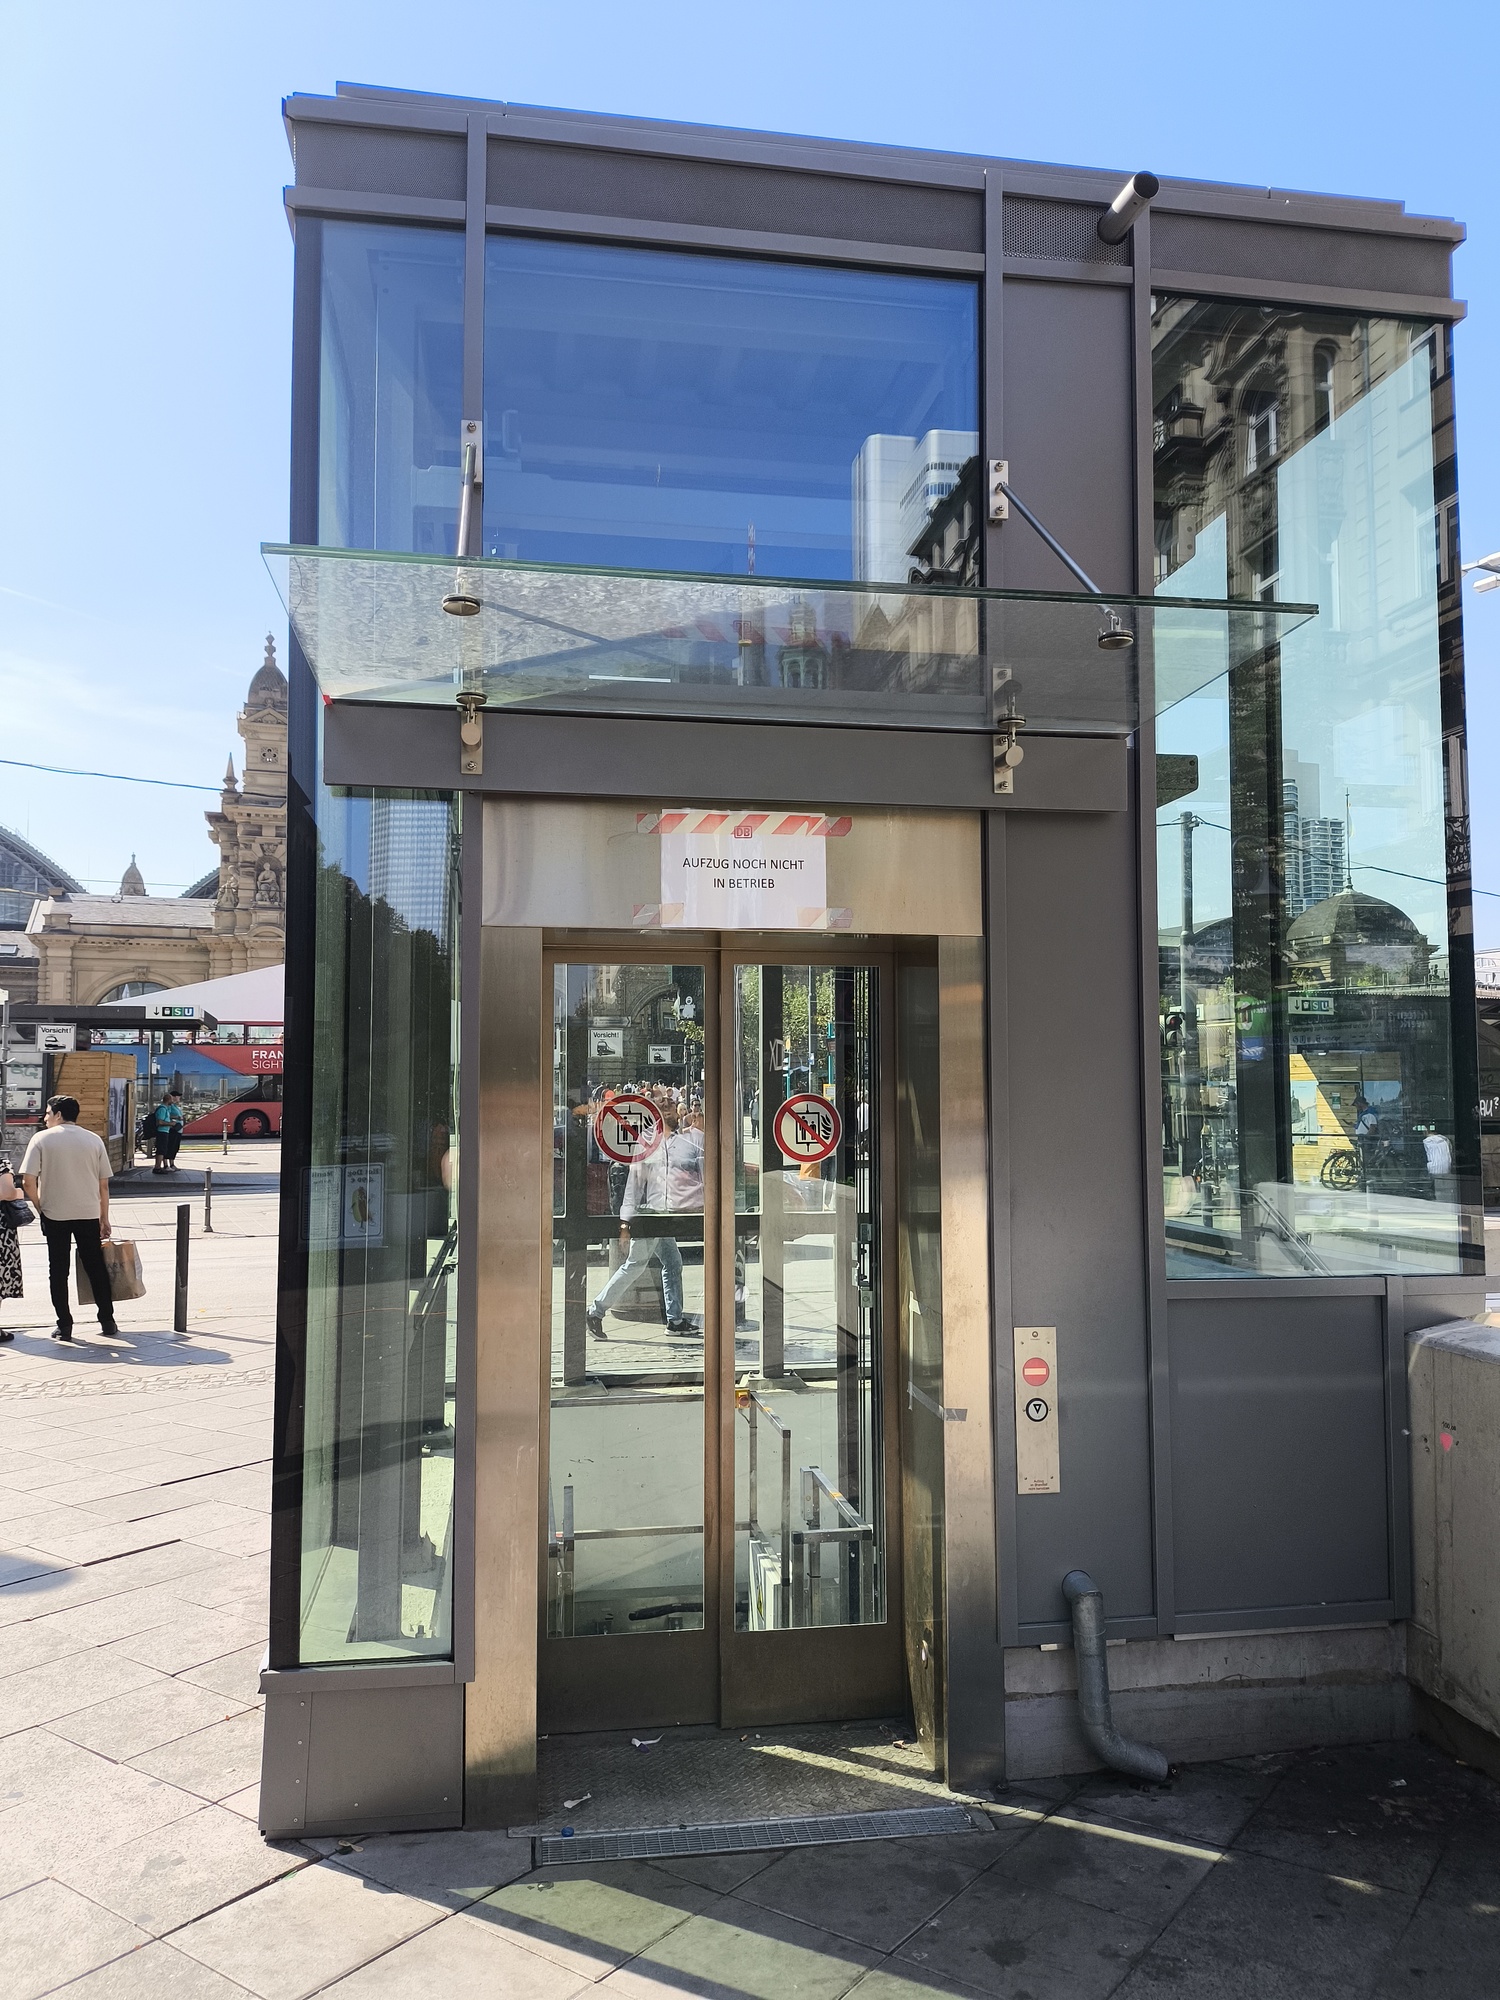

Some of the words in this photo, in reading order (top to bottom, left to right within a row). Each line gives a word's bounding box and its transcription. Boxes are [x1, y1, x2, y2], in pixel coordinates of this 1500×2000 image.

[736, 827, 751, 837] DB
[682, 857, 730, 869] AUFZUG
[733, 859, 767, 869] NOCH
[770, 860, 805, 870] NICHT
[713, 878, 725, 888] IN
[729, 878, 775, 889] BETRIEB
[174, 1007, 182, 1016] S
[184, 1007, 193, 1016] U
[41, 1026, 72, 1034] Vorsicht!
